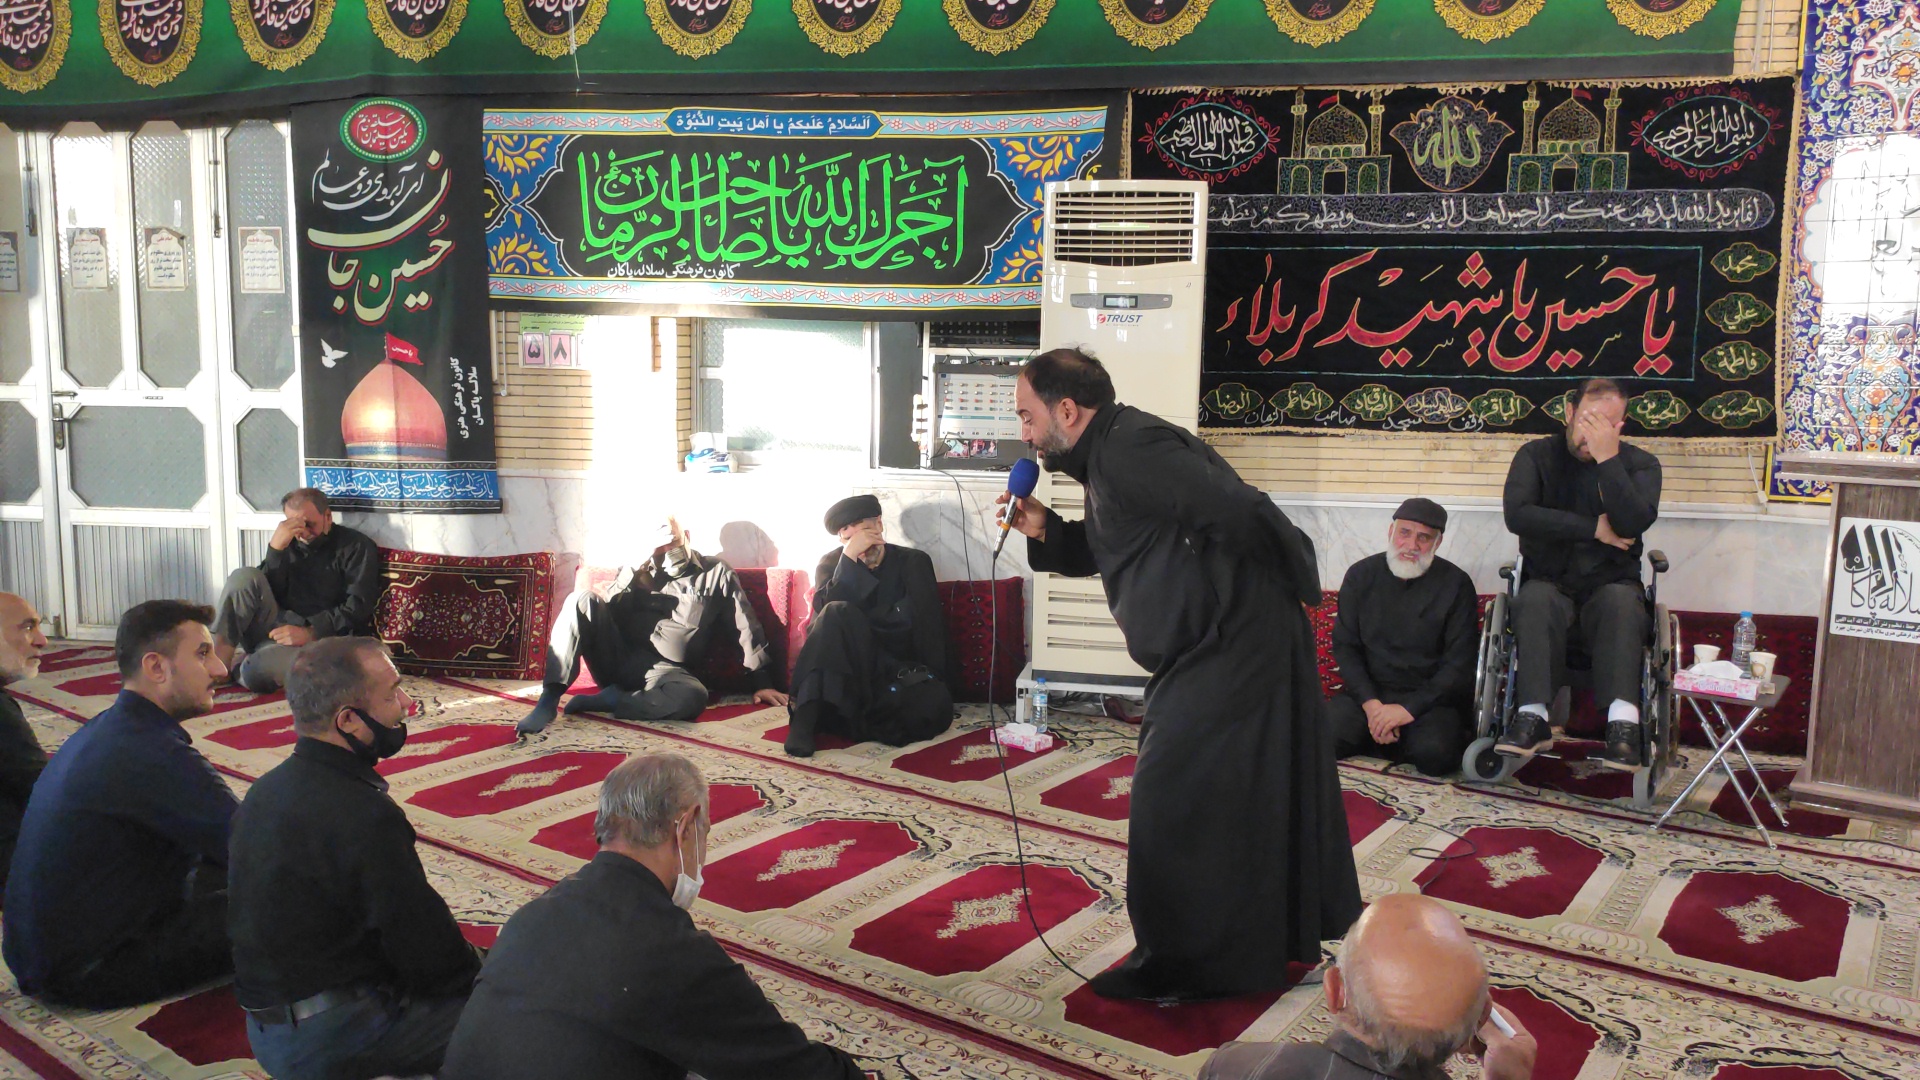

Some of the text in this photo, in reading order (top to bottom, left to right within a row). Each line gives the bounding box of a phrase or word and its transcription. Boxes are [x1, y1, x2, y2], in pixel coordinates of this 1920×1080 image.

[773, 118, 784, 134] یا
[1413, 106, 1482, 186] الله
[1722, 255, 1758, 274] محمد
[1106, 314, 1143, 323] TRUST
[1488, 260, 1657, 372] حسین
[1633, 286, 1675, 376] یا
